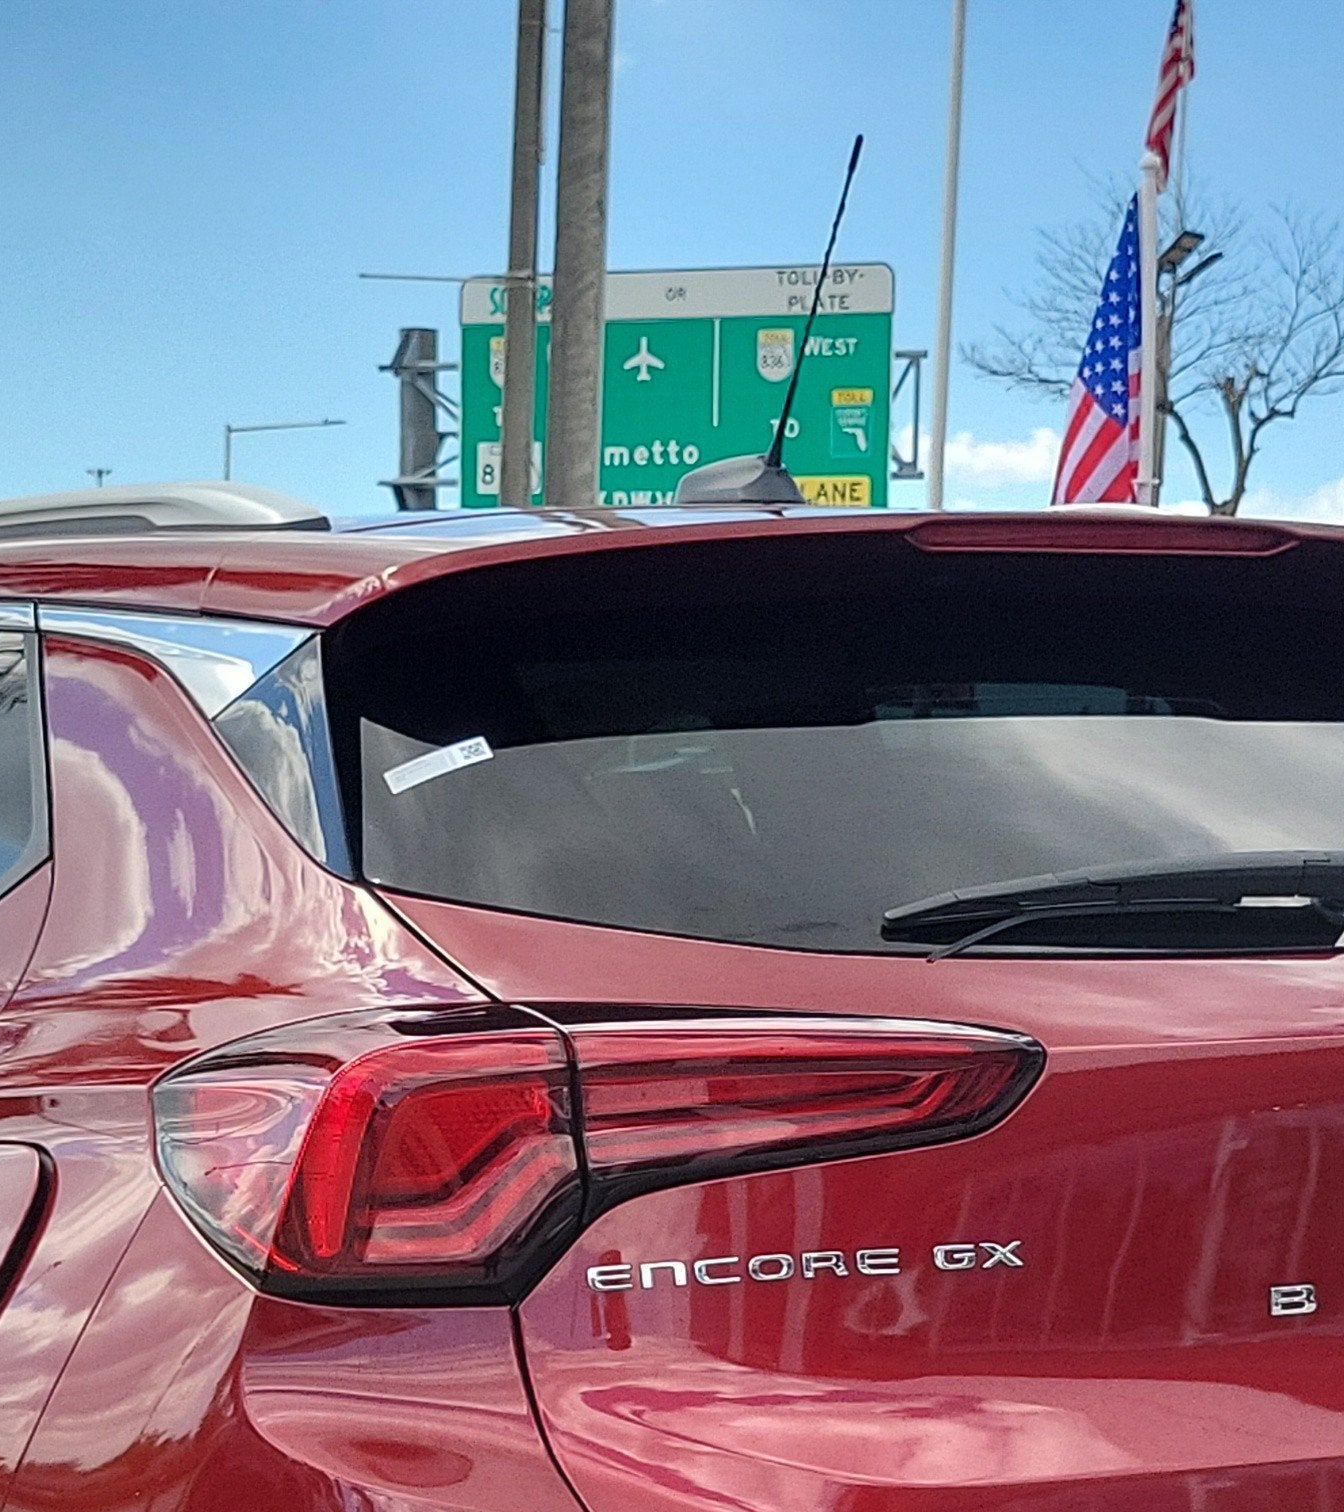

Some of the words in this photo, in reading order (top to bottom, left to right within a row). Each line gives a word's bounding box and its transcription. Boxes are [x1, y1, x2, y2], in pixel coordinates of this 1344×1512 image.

[805, 336, 857, 356] WEST
[604, 439, 700, 466] metto
[586, 1247, 901, 1292] ENCORE
[933, 1239, 1024, 1271] GX
